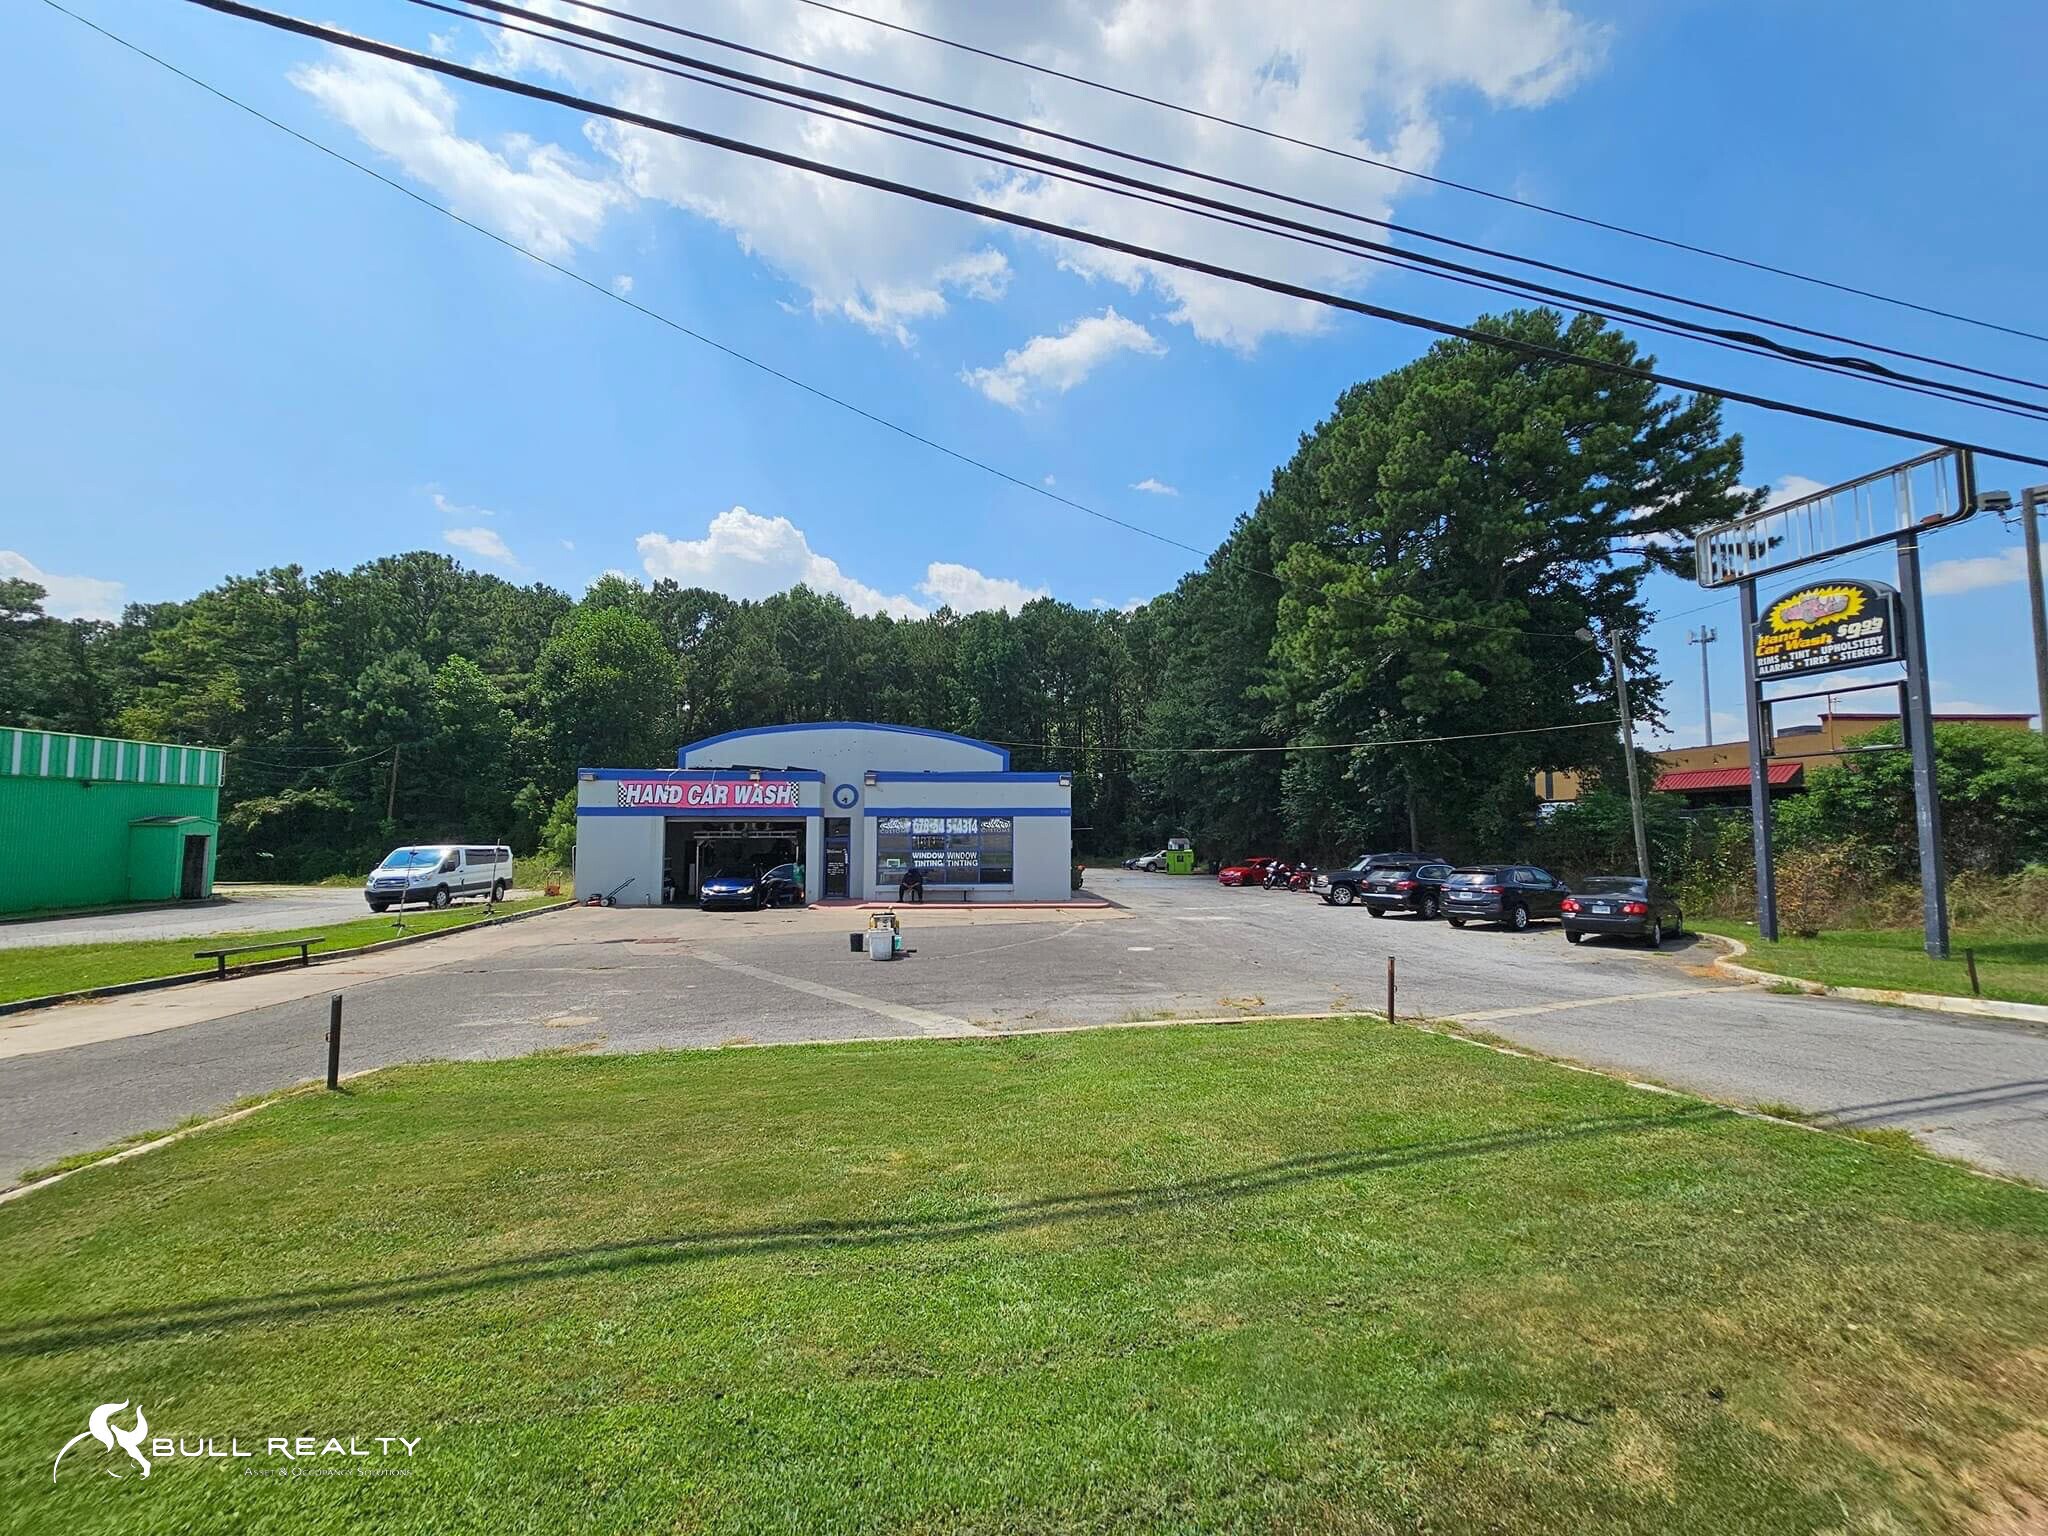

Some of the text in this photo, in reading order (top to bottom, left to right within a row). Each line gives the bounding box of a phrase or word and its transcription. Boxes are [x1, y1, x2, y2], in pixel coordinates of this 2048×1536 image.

[1755, 633, 1834, 657] Car Wash
[1758, 627, 1801, 646] Hand
[1758, 635, 1884, 667] RIMS TINT UPHOLSTERY
[1759, 645, 1884, 675] ALARMS TIRES STEREOS
[625, 783, 792, 805] HAND CAR WASH
[912, 851, 978, 859] WINDOW WINDOW
[913, 860, 943, 868] TINTING
